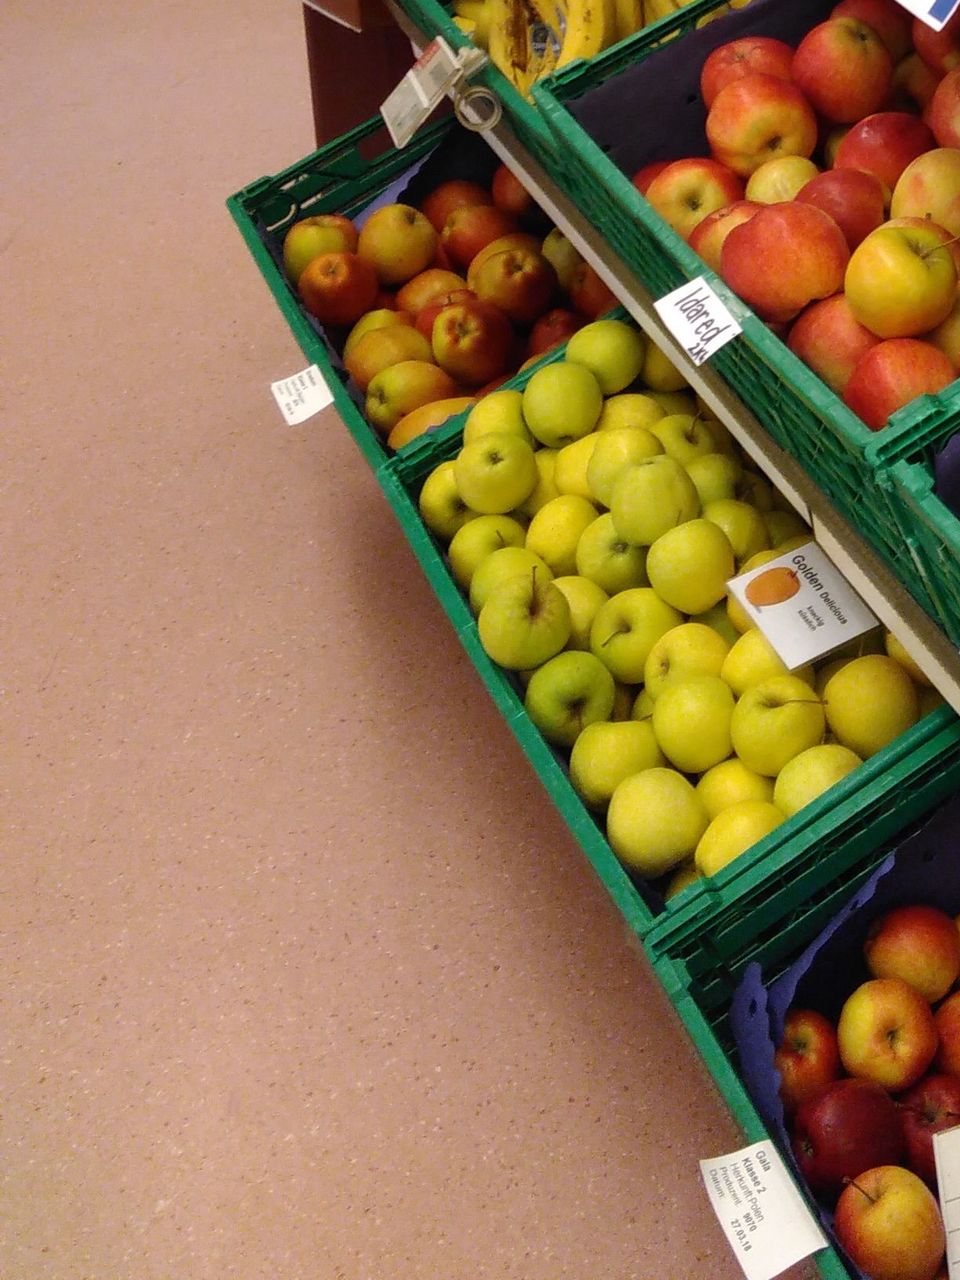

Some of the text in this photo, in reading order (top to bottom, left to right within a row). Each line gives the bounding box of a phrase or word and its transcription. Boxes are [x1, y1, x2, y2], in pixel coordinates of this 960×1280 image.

[674, 286, 733, 347] Idared
[792, 554, 849, 626] Golden Delicious
[730, 1161, 765, 1222] Herkunft Polen
[742, 1157, 767, 1195] Klasse 2
[755, 1150, 771, 1173] Gala
